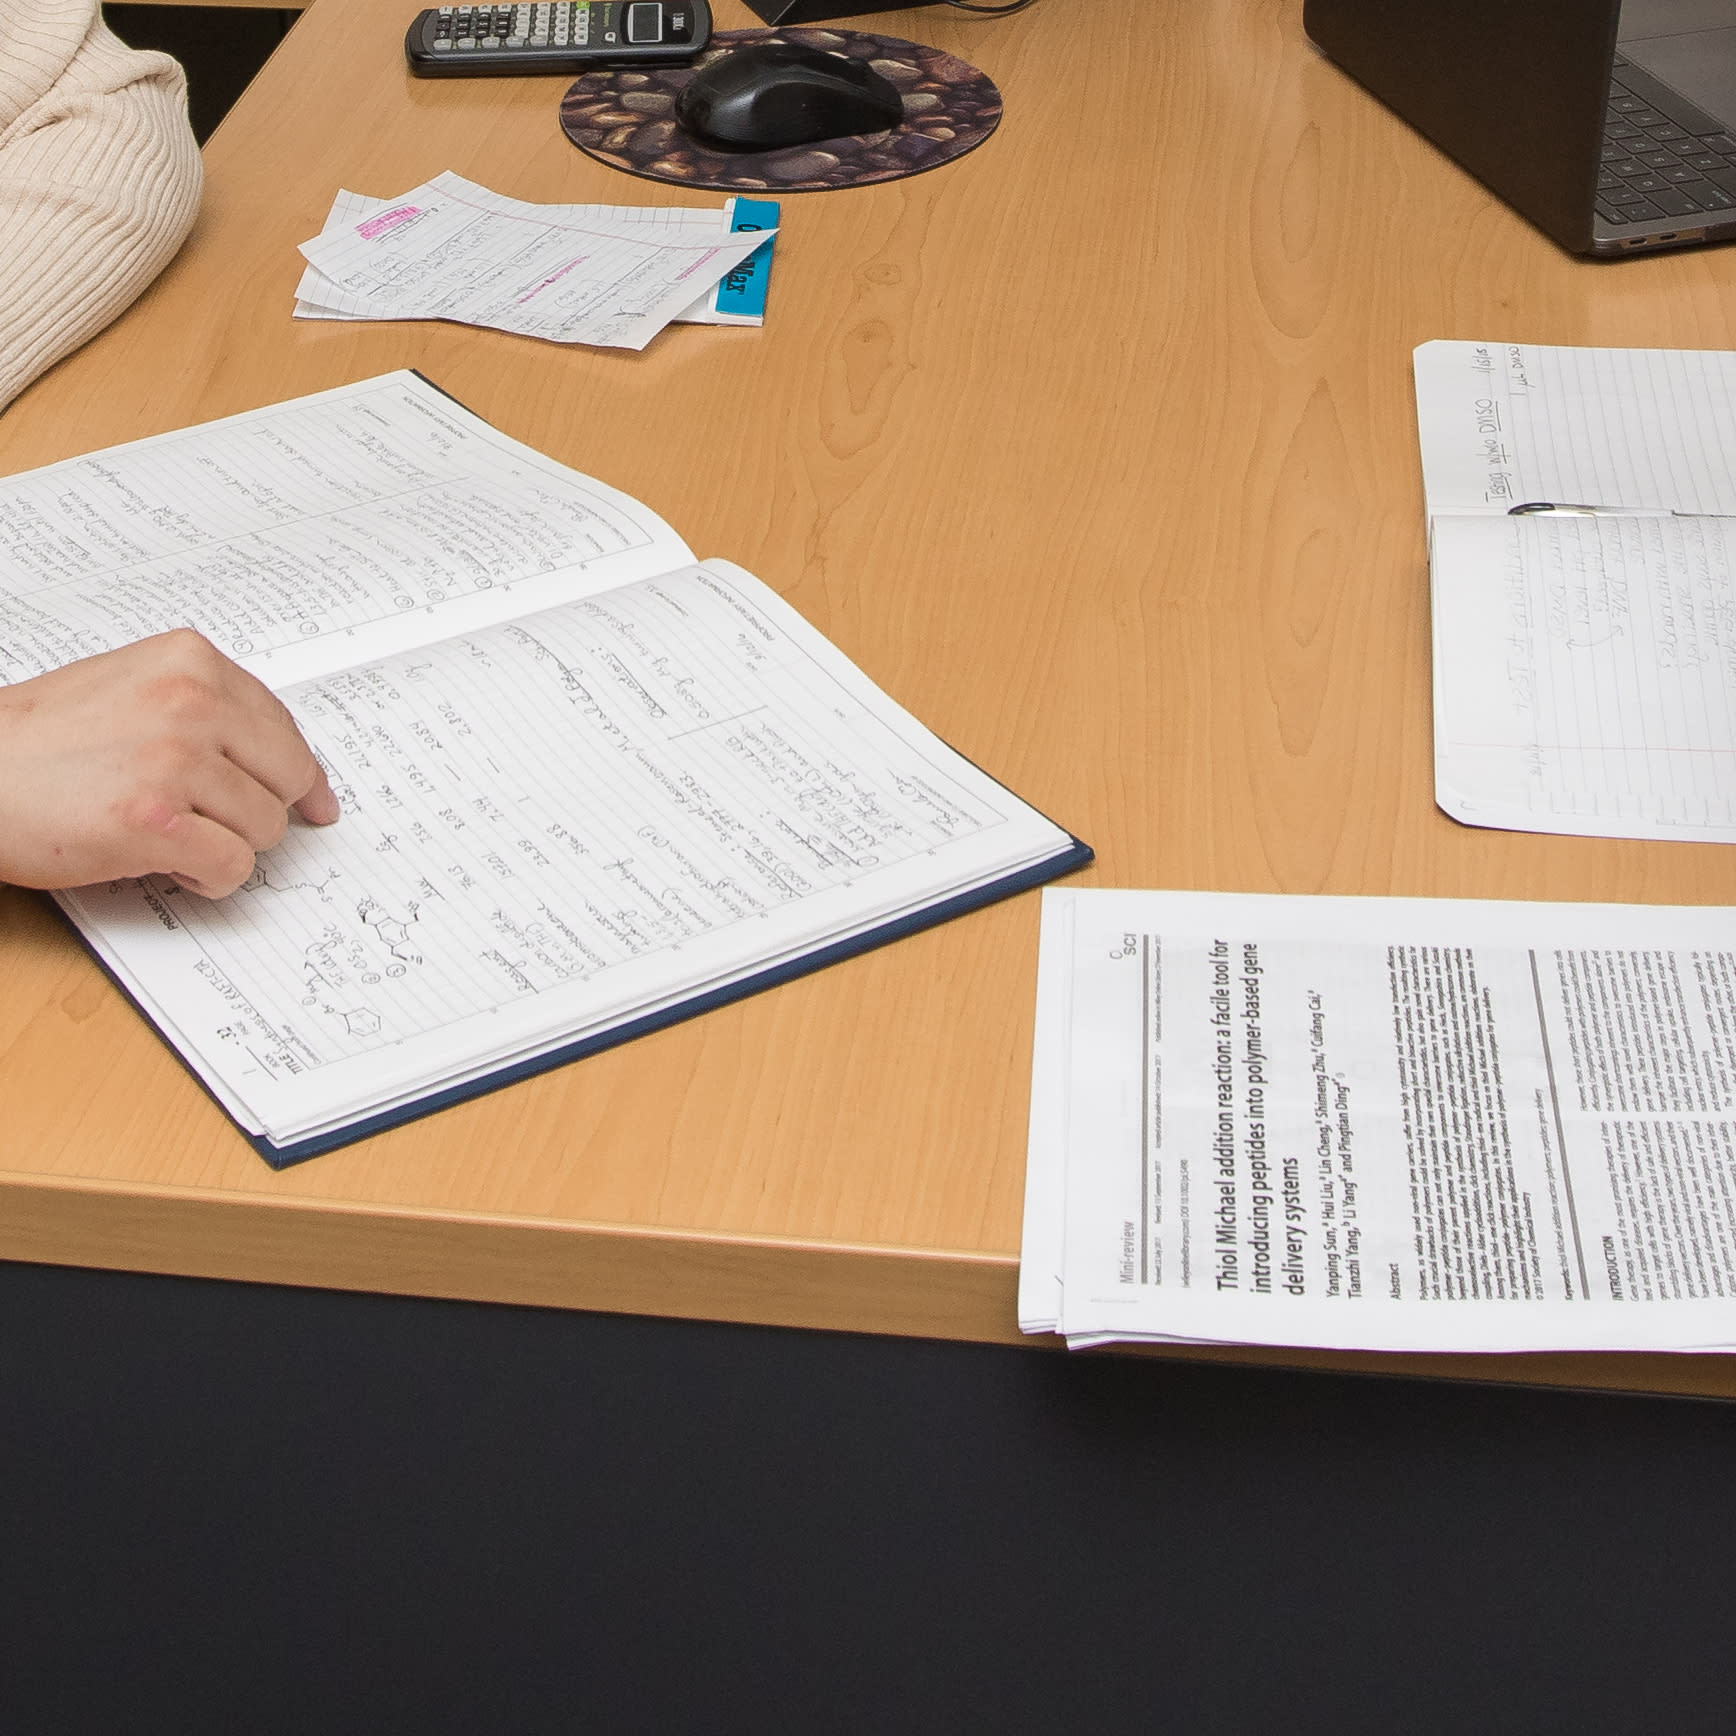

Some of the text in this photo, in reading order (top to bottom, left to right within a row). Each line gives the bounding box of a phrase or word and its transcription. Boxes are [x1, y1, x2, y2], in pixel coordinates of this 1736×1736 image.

[1475, 398, 1497, 433] DMSO
[1124, 934, 1137, 956] SCI
[1208, 939, 1228, 956] for
[1209, 960, 1228, 985] tool
[1209, 989, 1230, 1024] facile
[1310, 1012, 1324, 1046] Cuifang
[277, 1052, 304, 1074] TITLE
[1211, 1040, 1233, 1107] reaction:
[1312, 1074, 1328, 1117] Shimeng
[1237, 943, 1273, 1293] introducing peptides into polymer-based gene
[1335, 1112, 1353, 1151] Pingtian
[1212, 1112, 1235, 1176] addition
[1339, 1153, 1352, 1171] and
[1318, 1159, 1331, 1173] Lin
[1212, 1181, 1237, 1244] Michael
[1281, 1157, 1307, 1295] delivery systems
[1321, 1201, 1334, 1219] Hui
[1343, 1209, 1356, 1218] Li
[1120, 1221, 1135, 1283] Mini-review
[1214, 1249, 1238, 1290] Thiol
[1602, 1236, 1625, 1301] INTRODUCTION
[1325, 1253, 1341, 1297] Yanping
[1348, 1259, 1361, 1298] Tianzhi
[1387, 1264, 1402, 1300] Abstract
